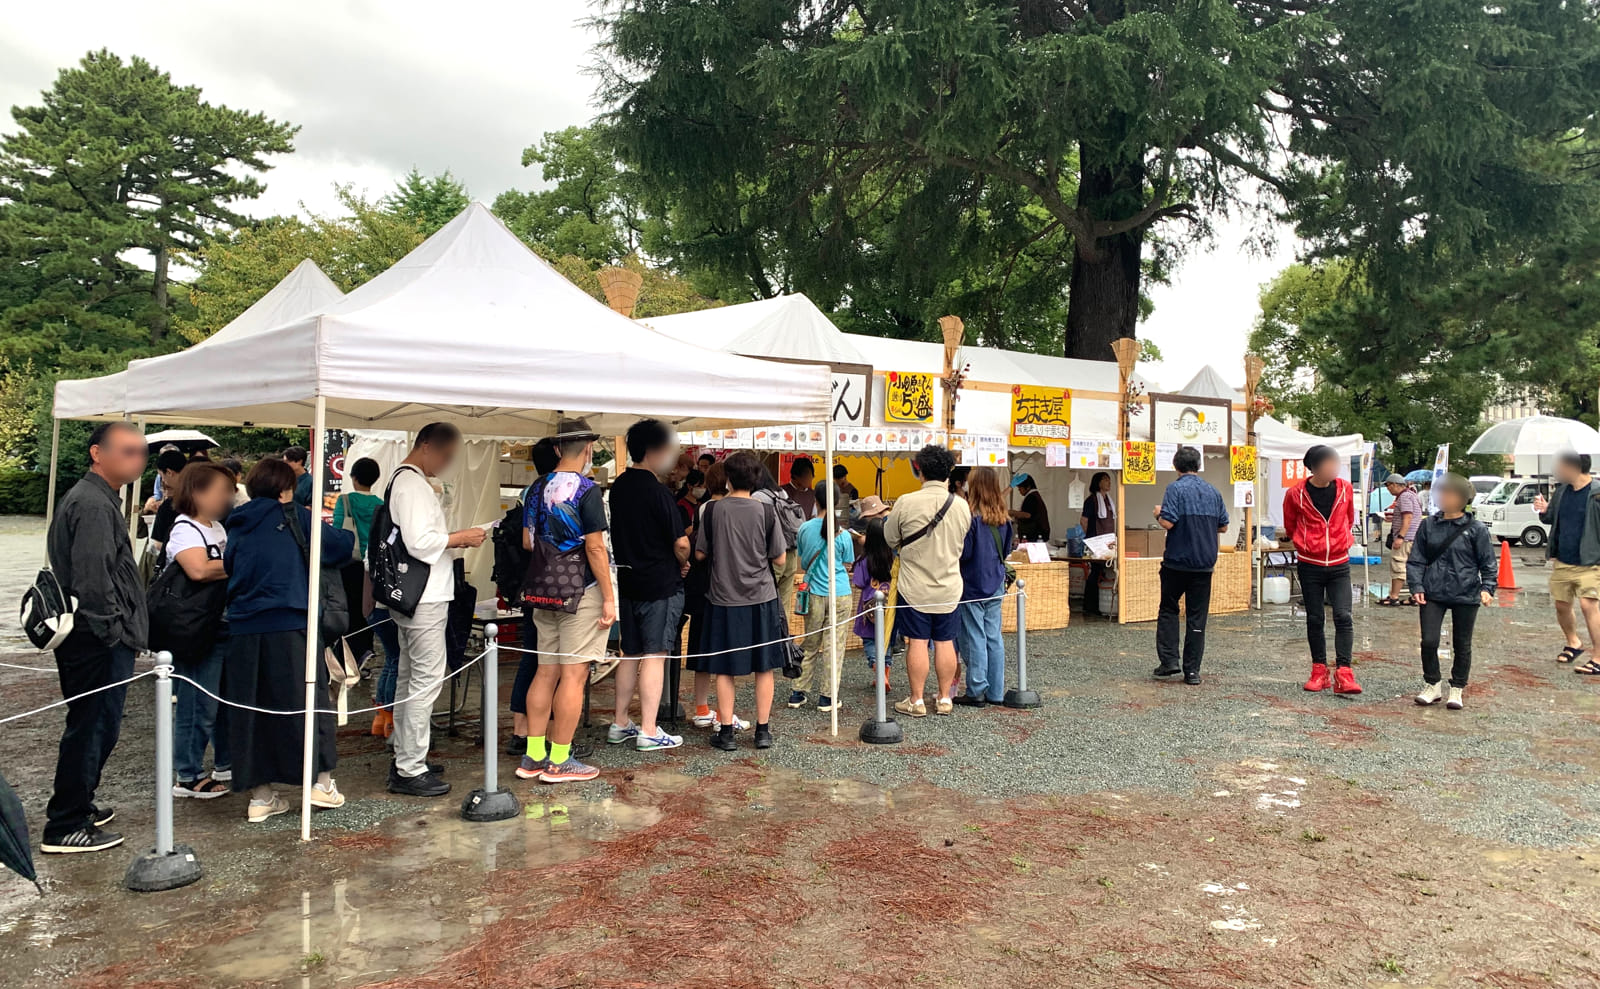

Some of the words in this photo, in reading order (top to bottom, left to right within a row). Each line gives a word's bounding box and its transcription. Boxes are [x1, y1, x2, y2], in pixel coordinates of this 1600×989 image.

[831, 377, 862, 421] ん
[1016, 393, 1067, 425] ちまき屋
